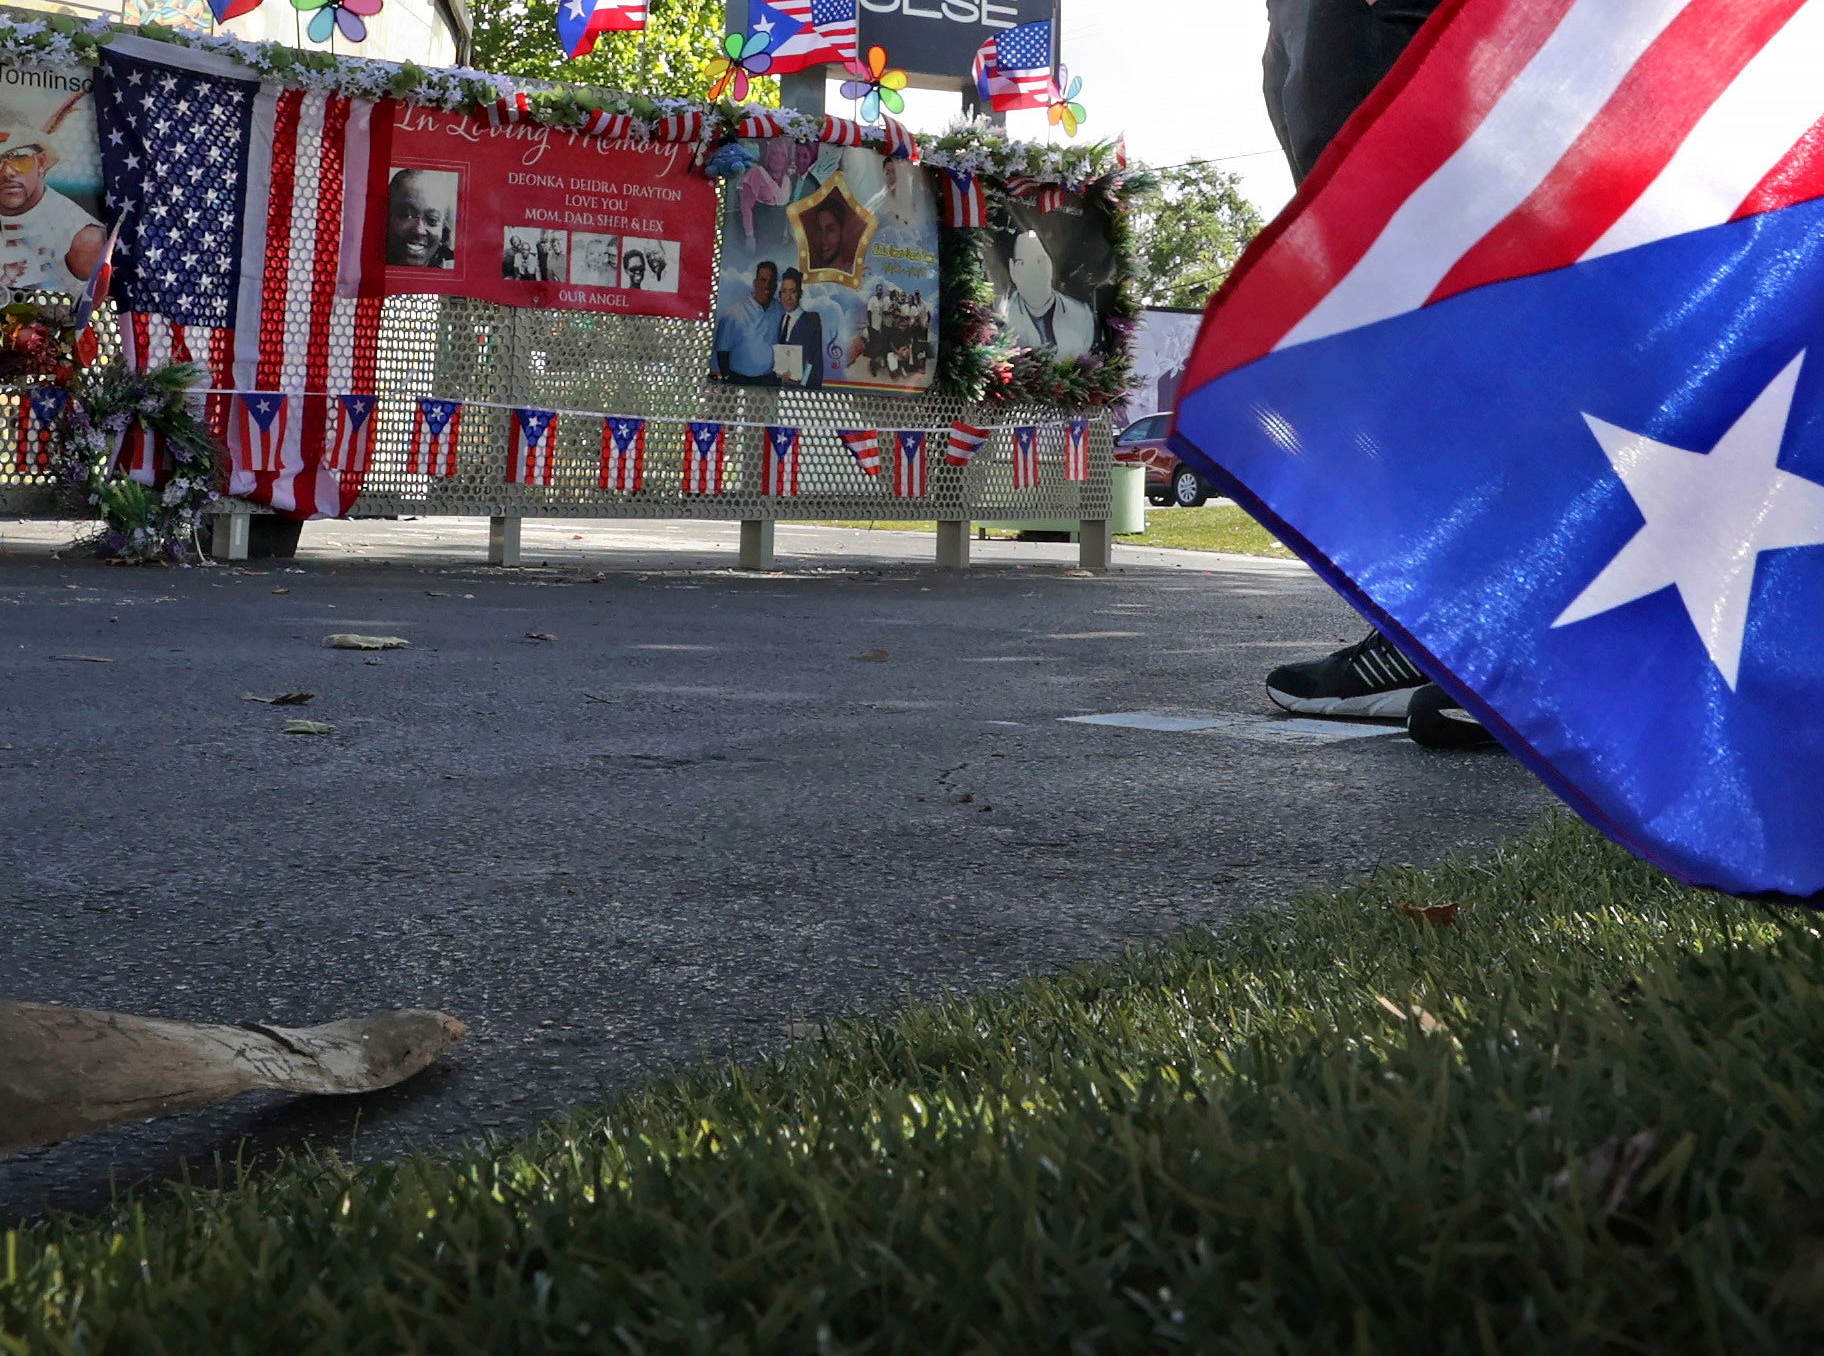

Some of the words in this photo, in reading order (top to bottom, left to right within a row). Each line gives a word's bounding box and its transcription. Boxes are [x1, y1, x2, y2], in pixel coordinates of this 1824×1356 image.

[393, 101, 440, 132] In
[445, 114, 552, 166] Loving
[507, 171, 565, 189] DEONKA
[570, 177, 618, 194] DEIDRA
[623, 183, 682, 201] DRAYTON
[565, 194, 598, 209] LOVE
[601, 197, 629, 212] YOU
[525, 208, 563, 223] MOM,
[564, 211, 595, 226] DAD,
[630, 217, 641, 232] &
[642, 218, 665, 233] LEX
[558, 289, 587, 303] OUR
[589, 292, 630, 307] ANGEL
